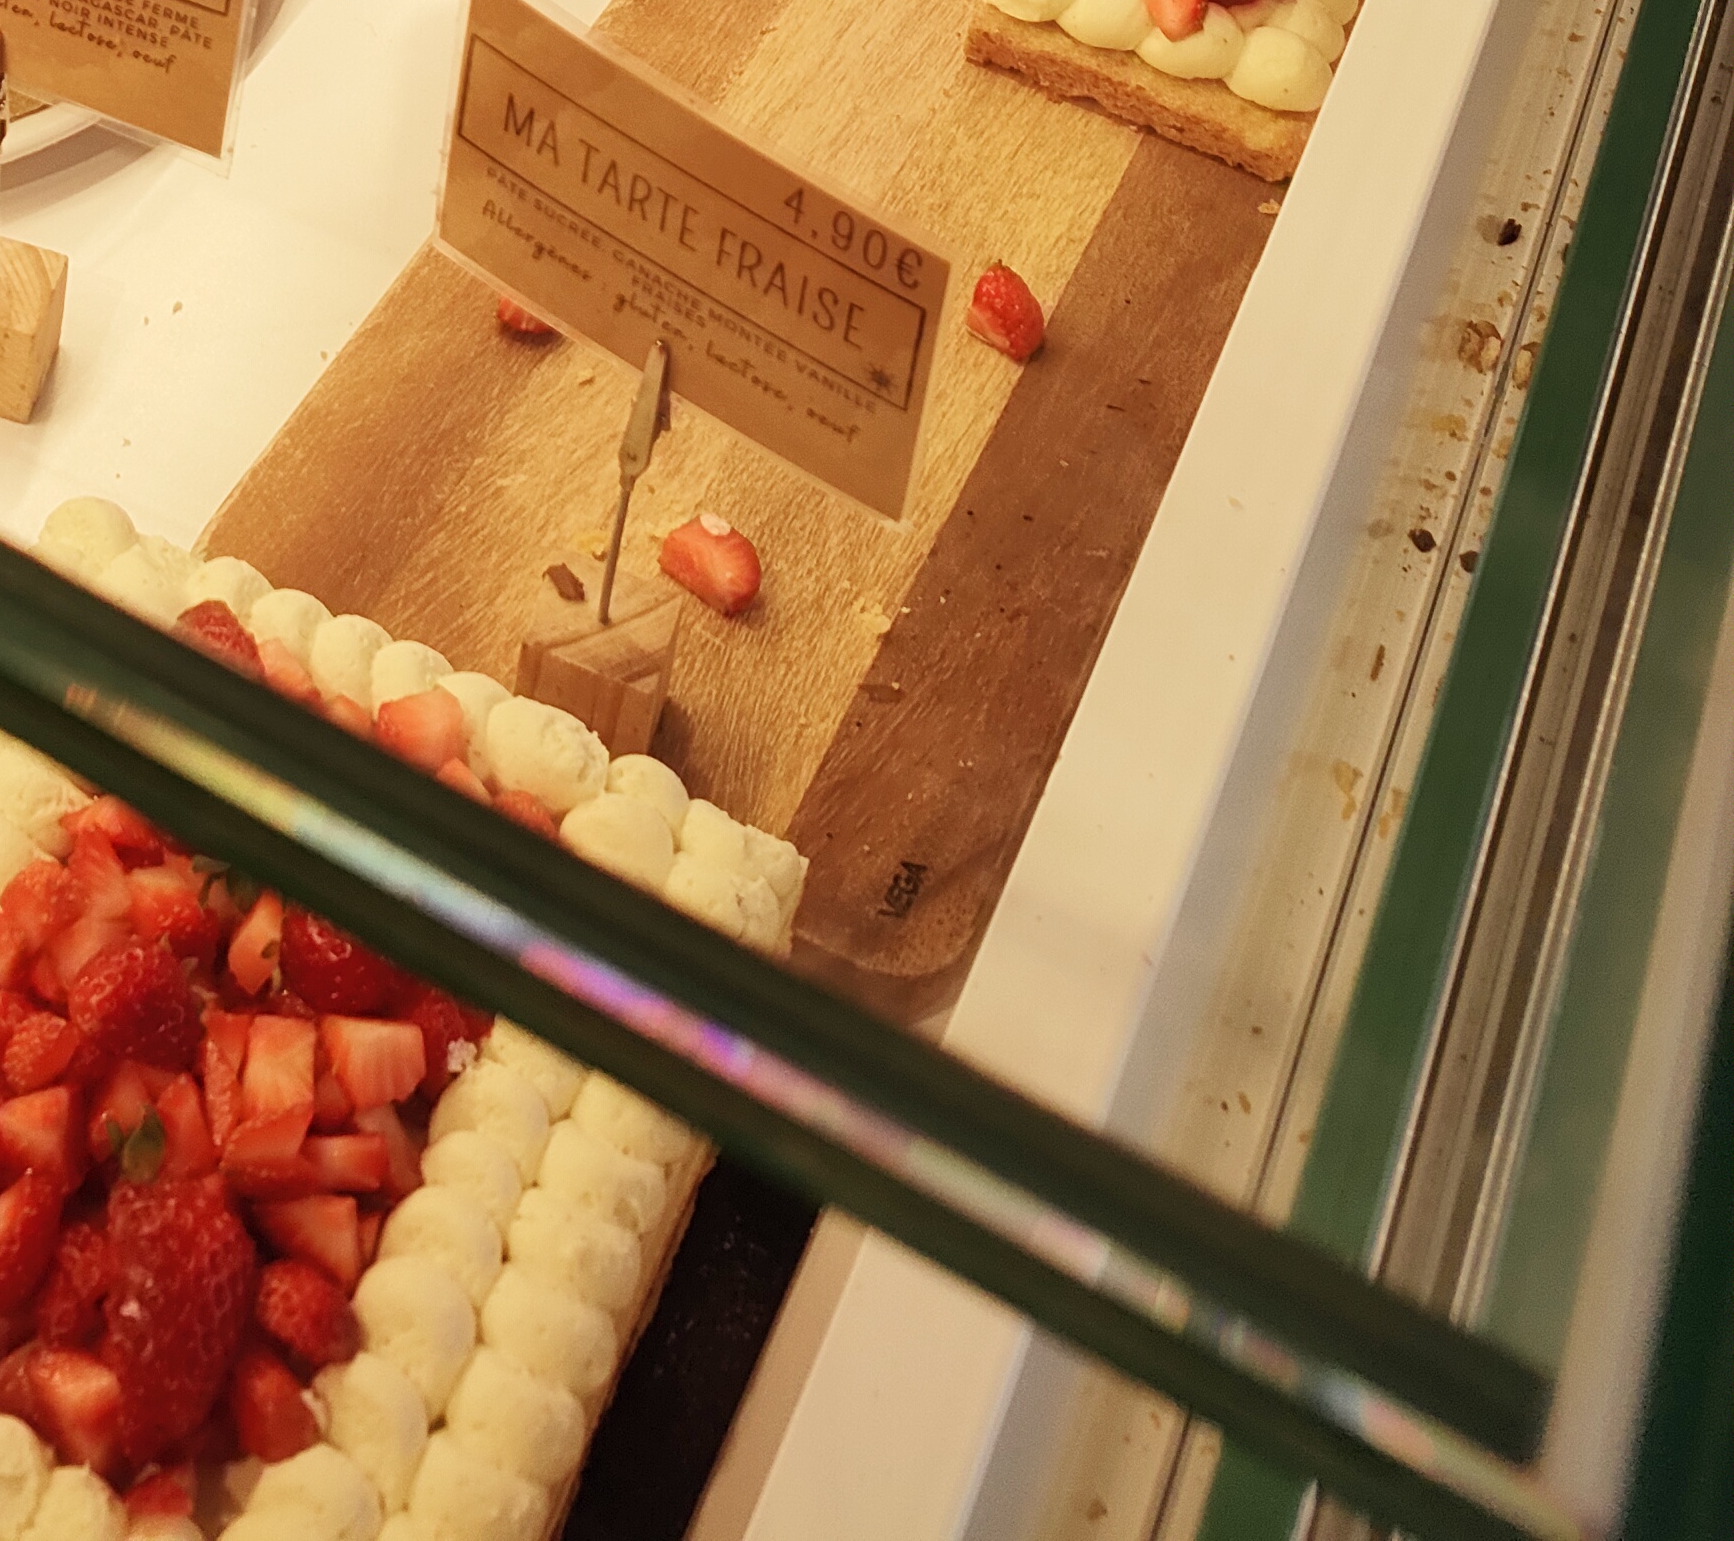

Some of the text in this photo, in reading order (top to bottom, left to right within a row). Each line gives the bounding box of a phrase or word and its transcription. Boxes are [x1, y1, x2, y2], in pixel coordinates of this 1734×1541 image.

[97, 12, 169, 48] INTENSE
[142, 0, 200, 29] FERME
[169, 23, 212, 50] PÂTE
[502, 91, 866, 351] MA TARTE FRAISE
[782, 187, 925, 291] 4,90€
[795, 359, 877, 414] VANILLE
[877, 860, 928, 919] VEGA
